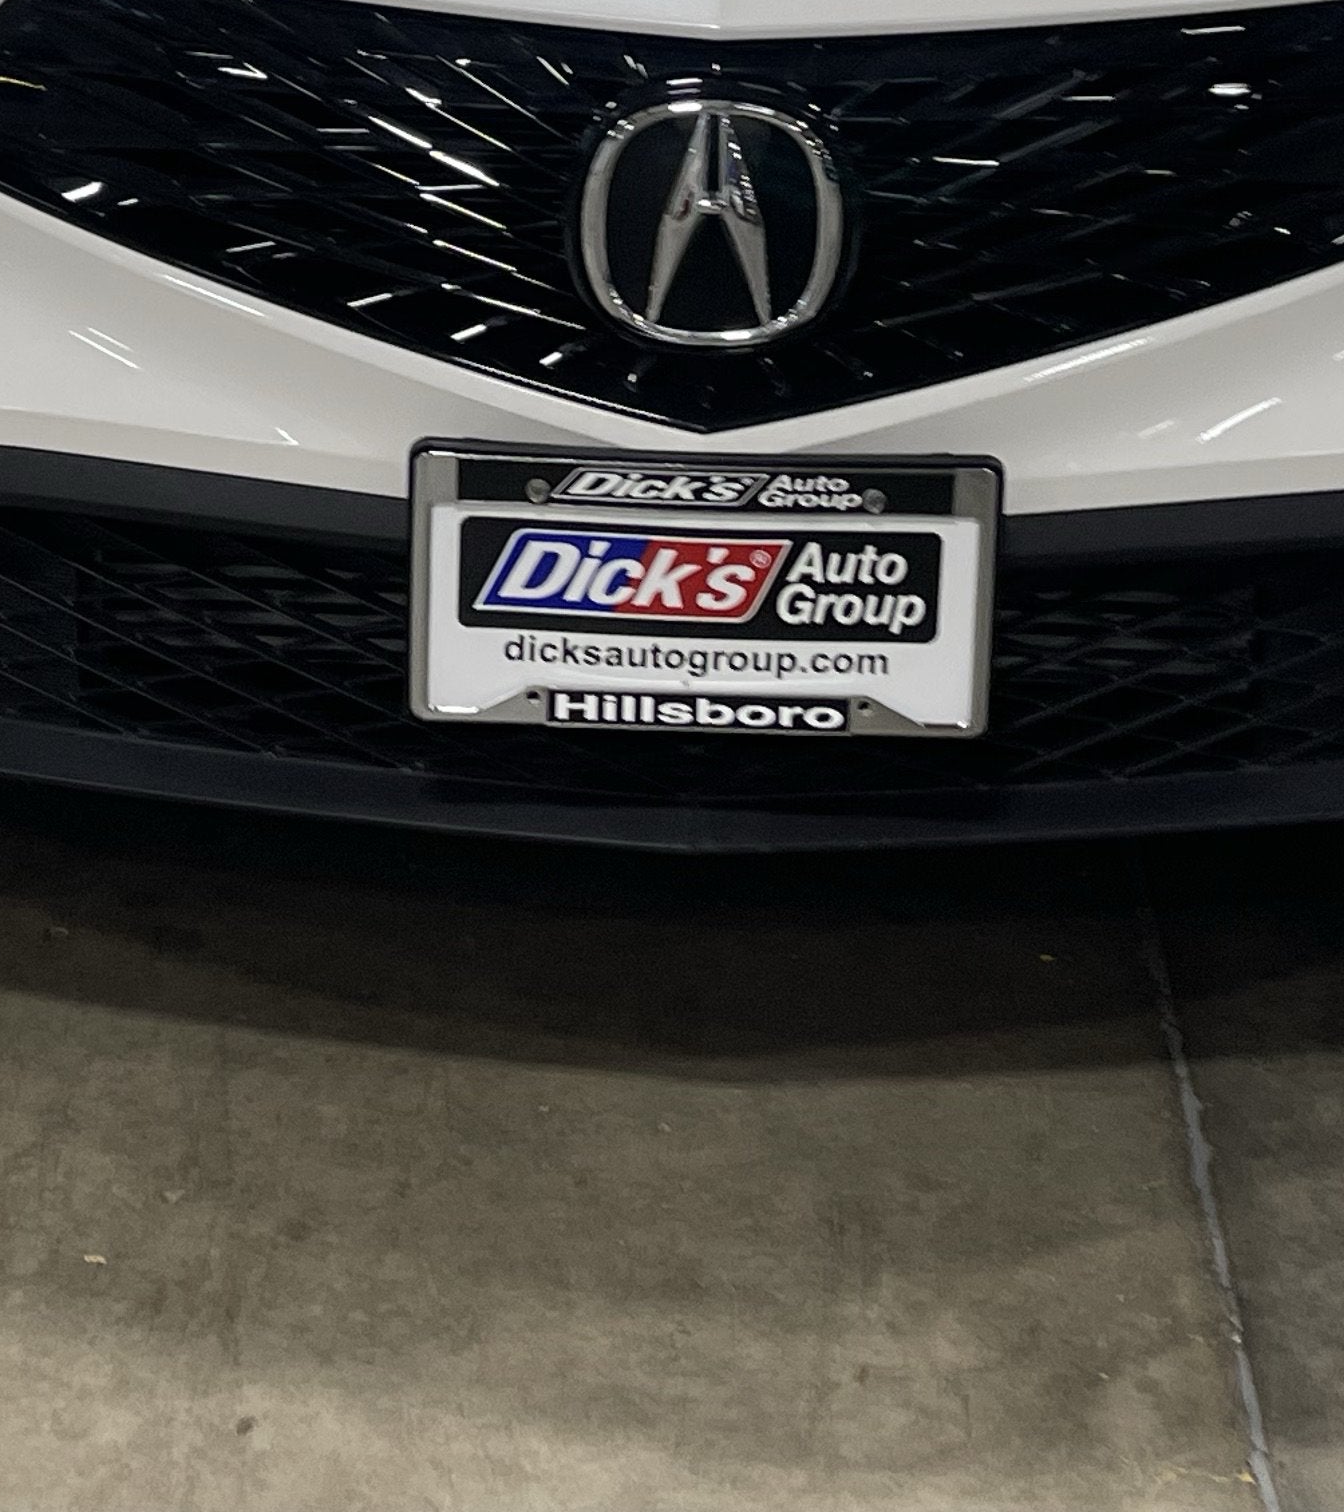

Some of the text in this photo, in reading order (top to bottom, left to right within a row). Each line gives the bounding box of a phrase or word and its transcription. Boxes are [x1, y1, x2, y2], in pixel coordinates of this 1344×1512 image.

[758, 489, 863, 511] Group
[769, 474, 851, 492] Auto
[499, 540, 926, 634] Dick's Auto Group
[504, 635, 889, 677] dicksautogroup.com
[554, 692, 844, 730] Hillsboro
